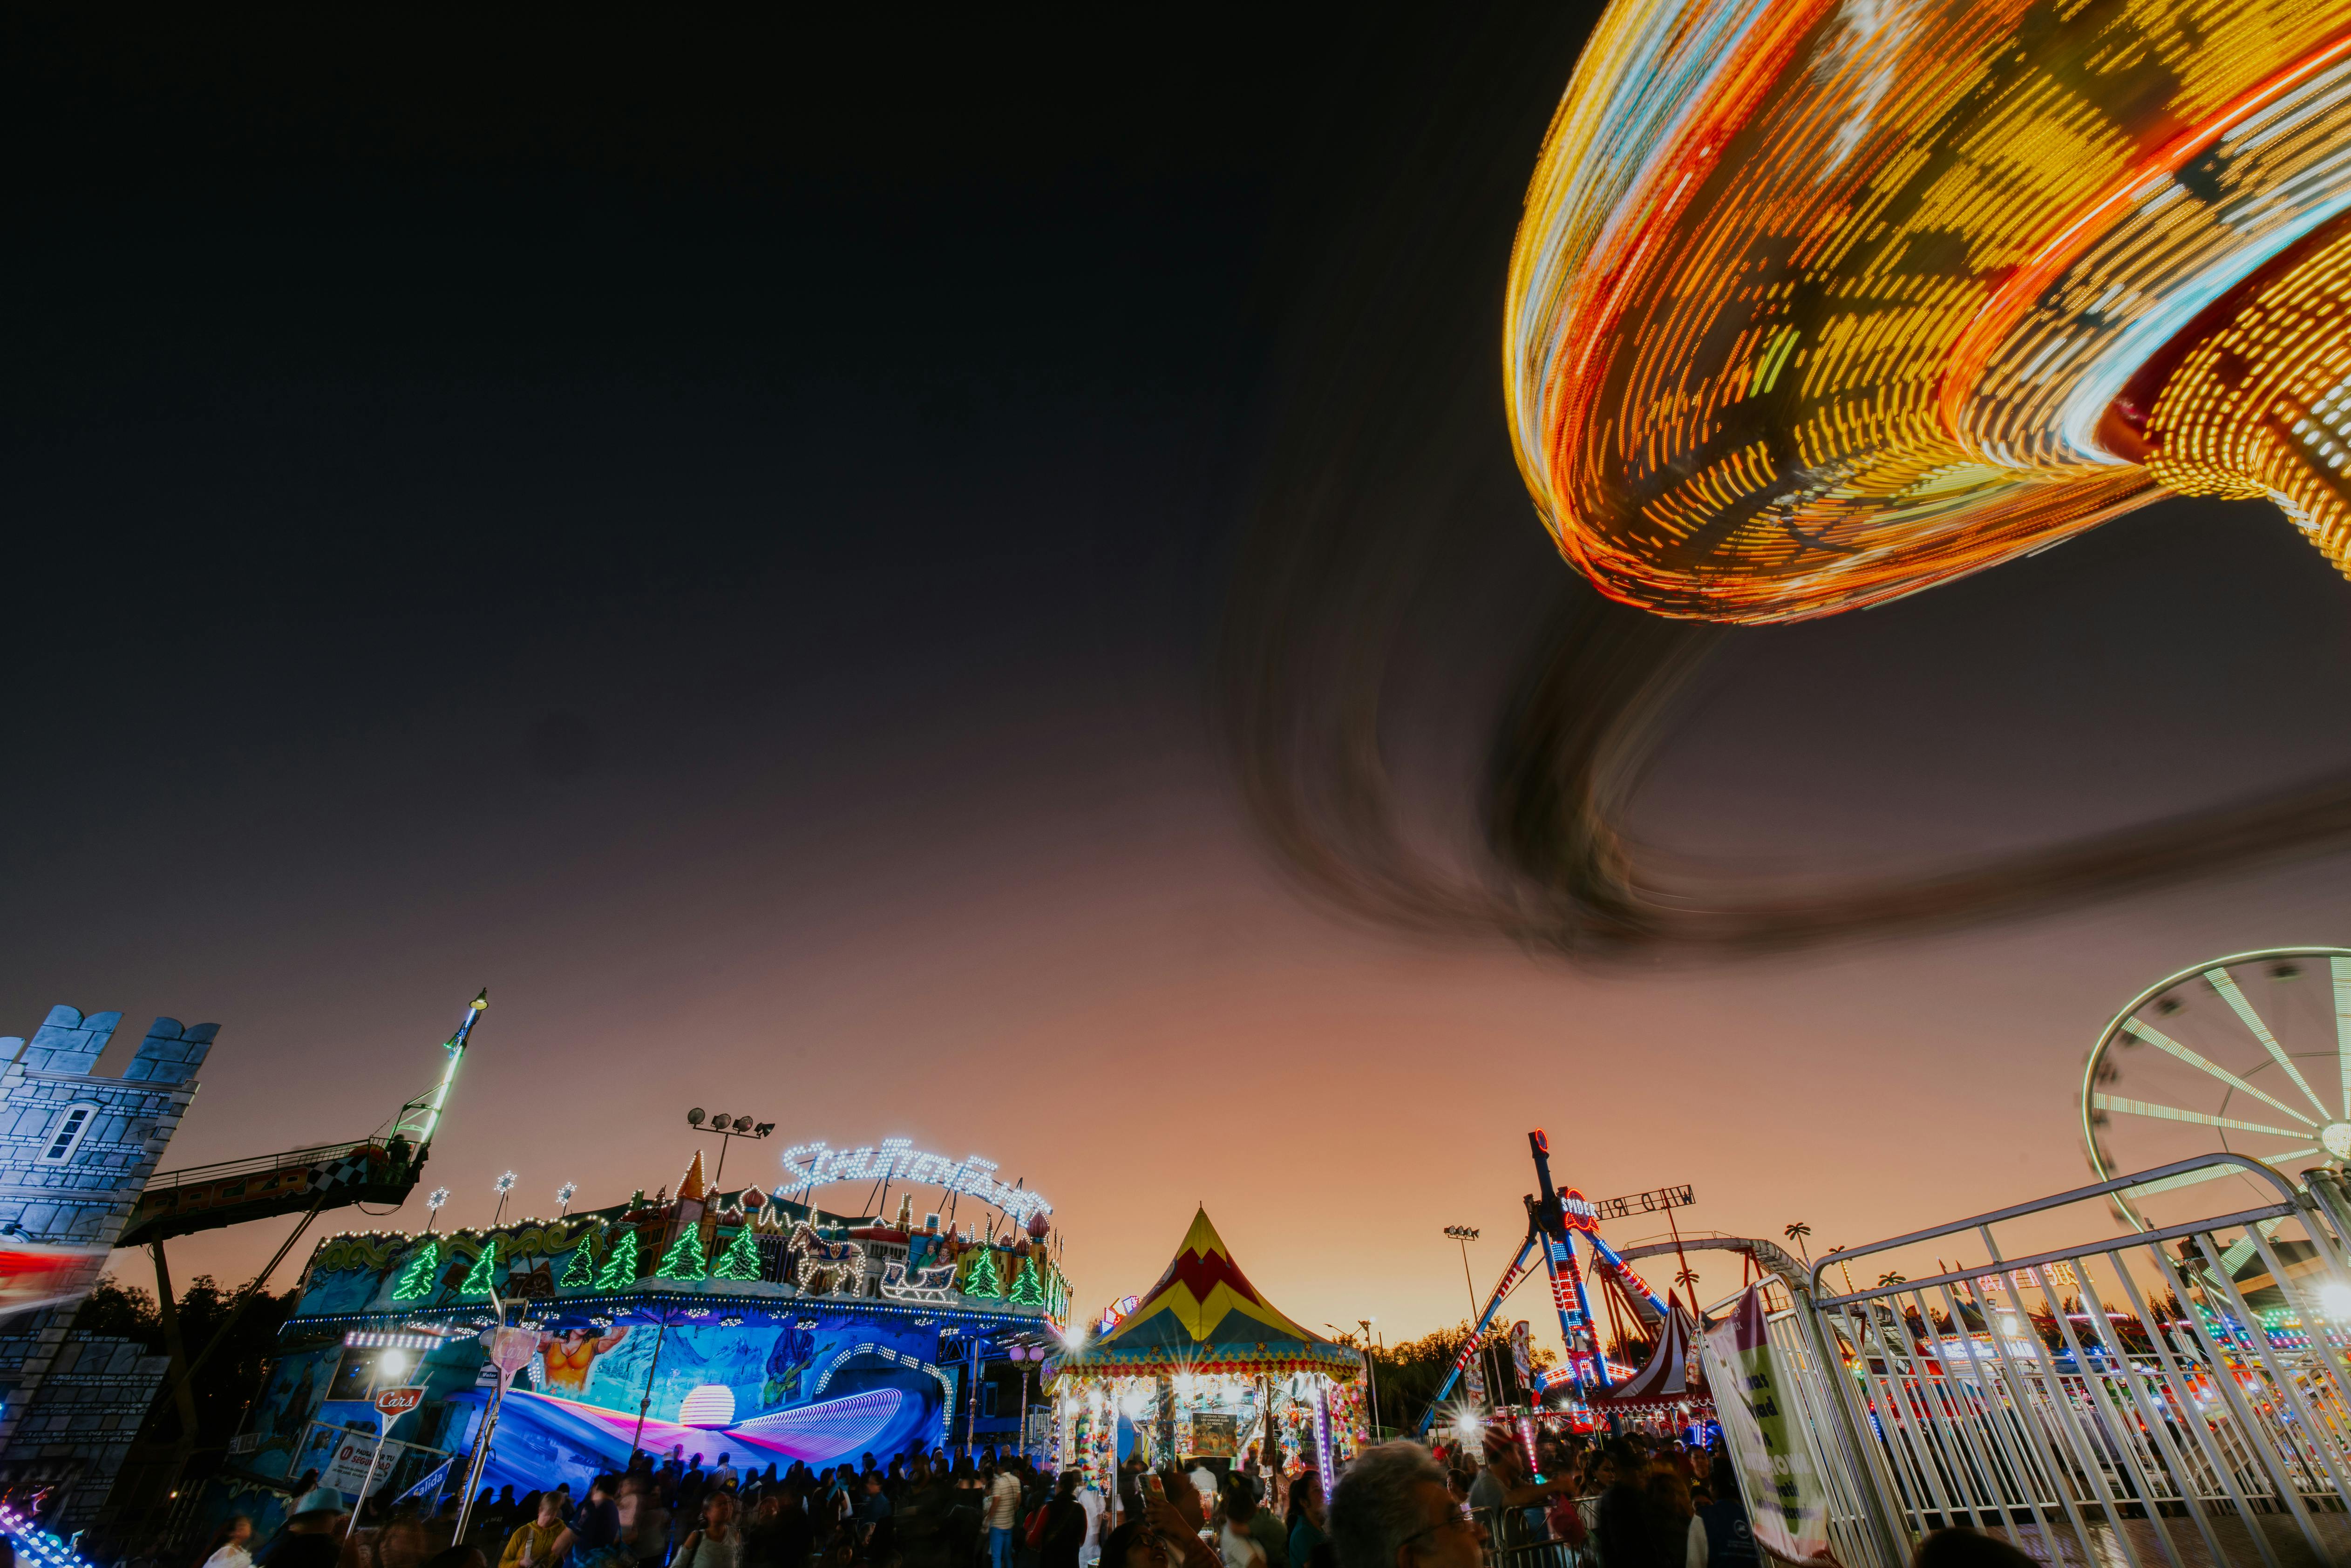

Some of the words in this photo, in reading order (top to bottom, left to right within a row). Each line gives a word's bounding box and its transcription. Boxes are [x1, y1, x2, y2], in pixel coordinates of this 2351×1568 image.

[141, 1166, 310, 1221] RACER
[1561, 1197, 1597, 1218] SPIDER
[498, 1337, 530, 1360] Cars
[378, 1392, 414, 1407] Cars
[356, 1448, 372, 1457] PAUSA
[351, 1455, 391, 1470] SEGURDAD
